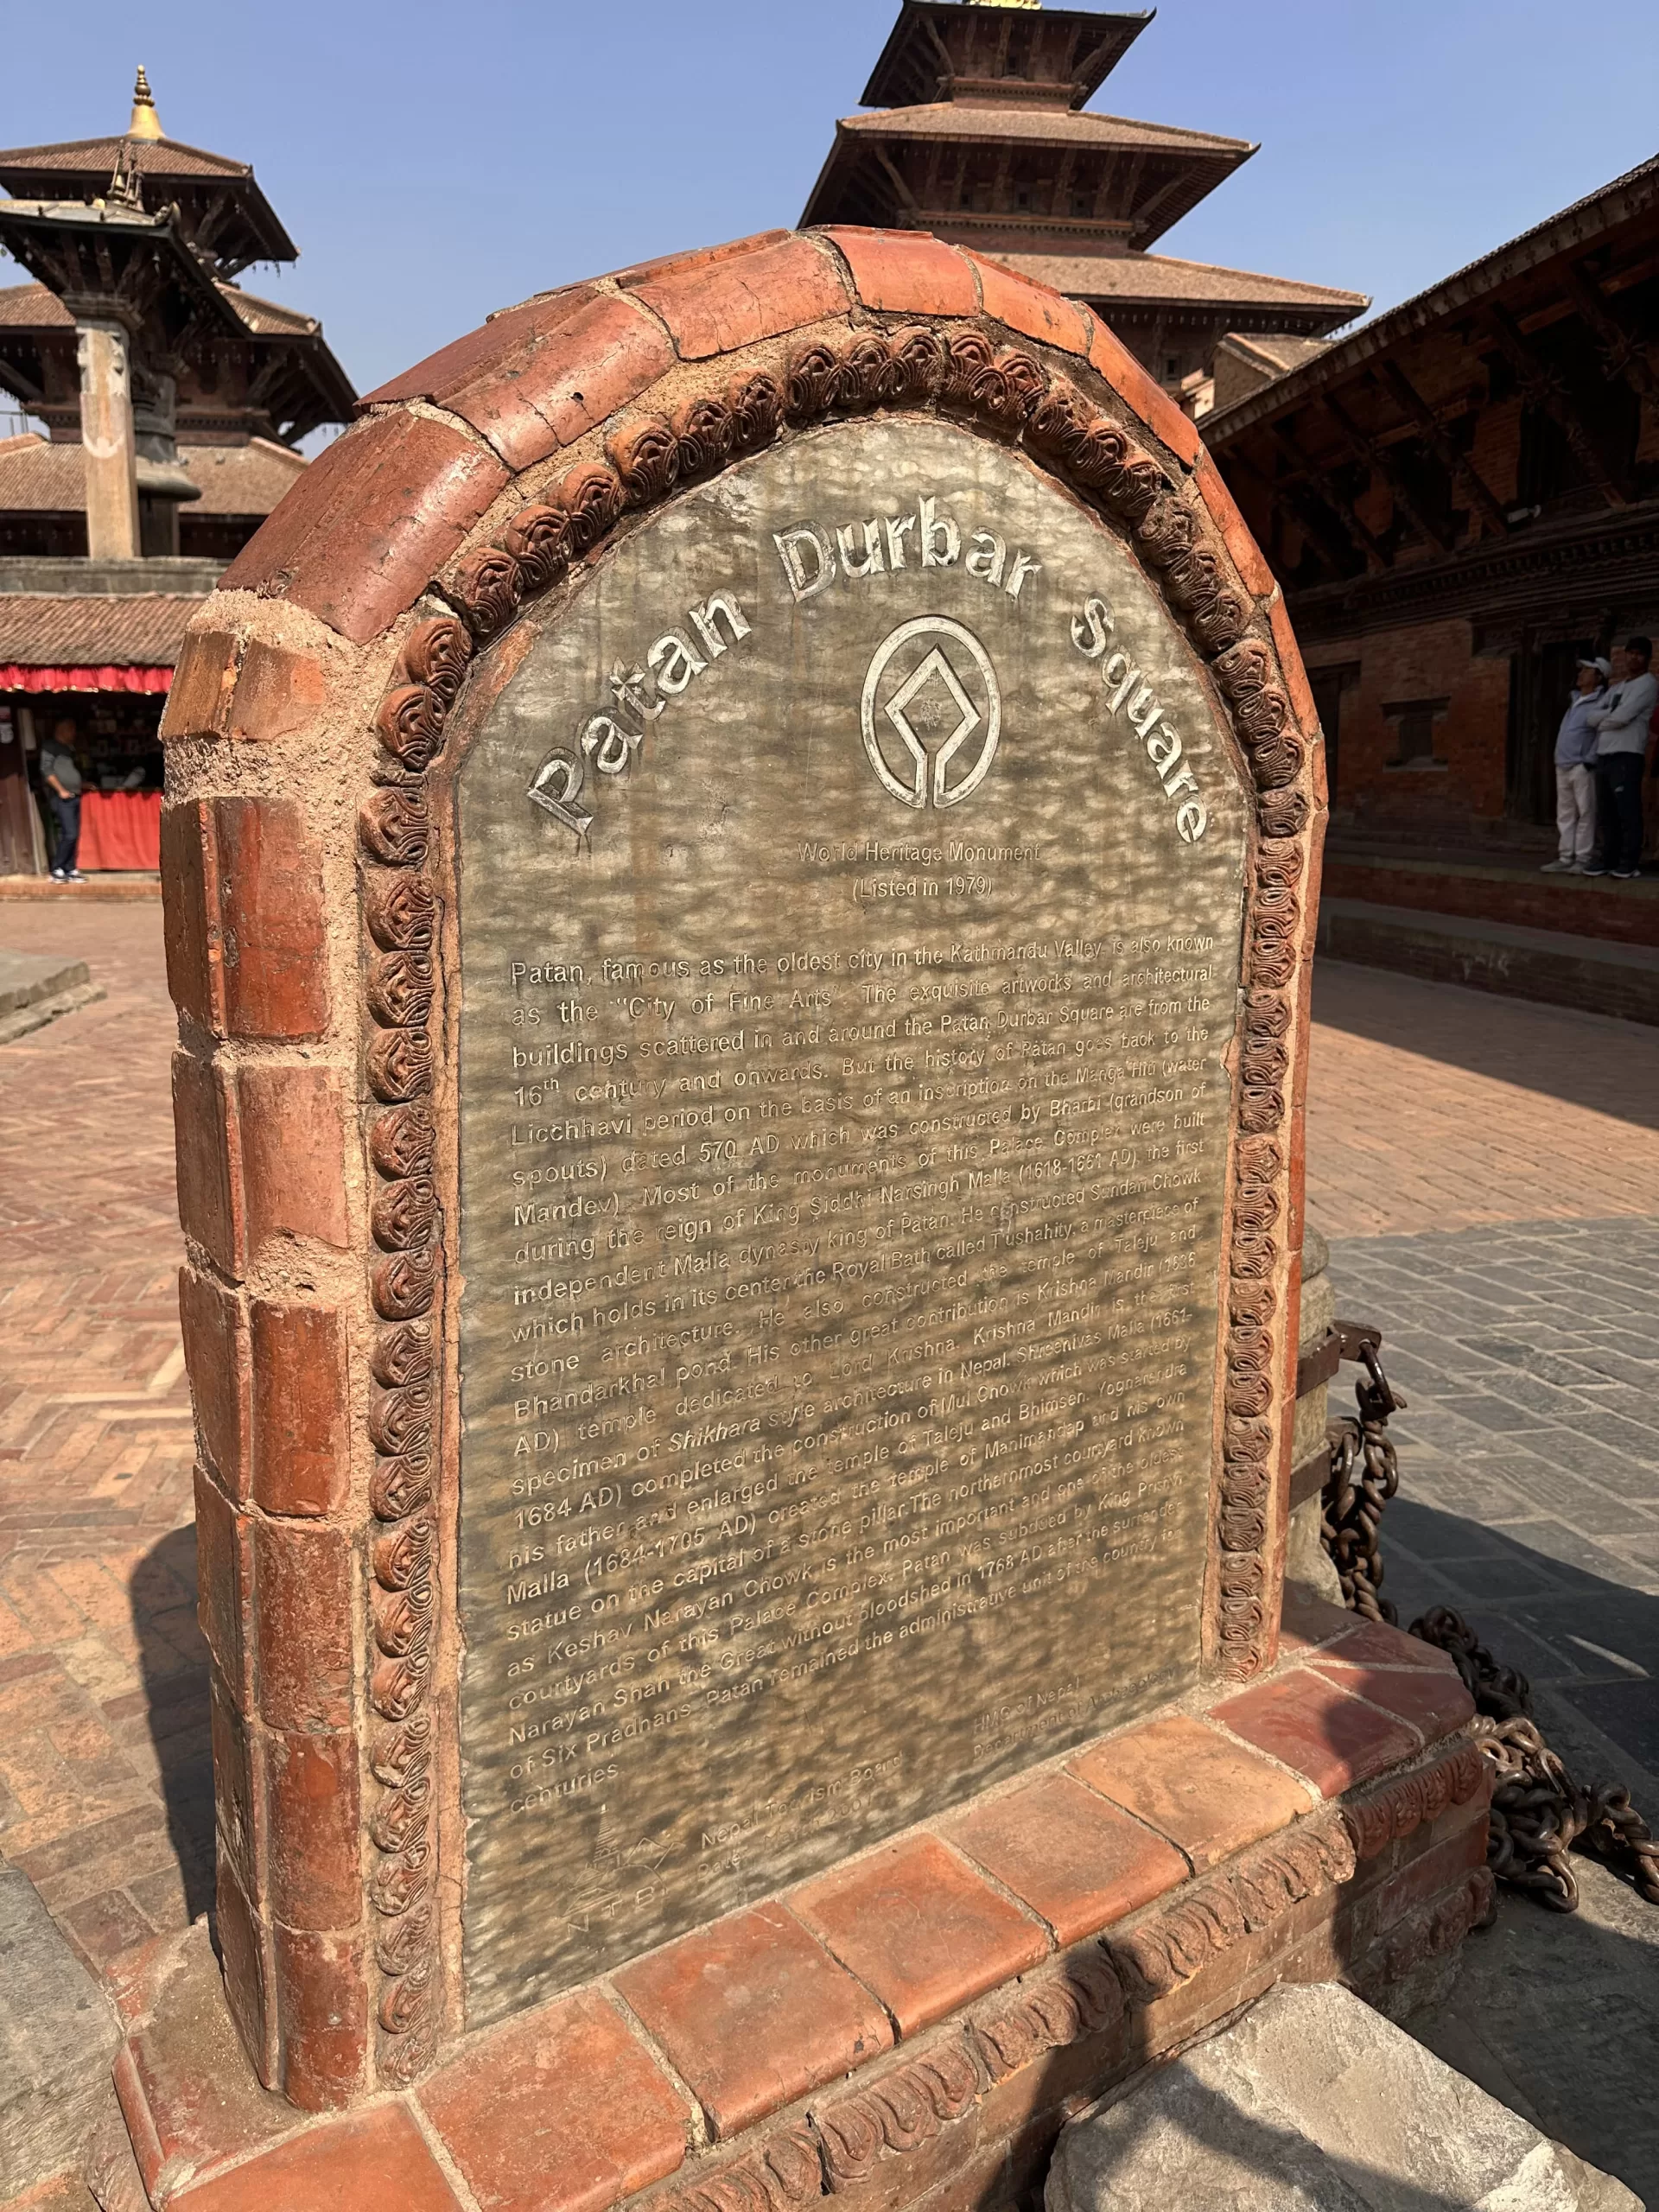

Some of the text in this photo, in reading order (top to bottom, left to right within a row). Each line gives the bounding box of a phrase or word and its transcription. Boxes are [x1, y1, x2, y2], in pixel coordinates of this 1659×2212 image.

[527, 496, 1207, 843] Patan Durbar Square
[798, 840, 1041, 866] World Heritage Monument
[852, 875, 994, 904] (Listed in 1979)
[512, 934, 1213, 985] Patan, famous as the oldest city in the Kathmandu is also known
[559, 963, 1212, 1023] the Fine The exquisite artworks and architectural
[512, 995, 1210, 1068] buildings scattered and around the Durbar Square are from the
[575, 1025, 1208, 1102] century and onwards. But the history Patan goes back the
[512, 1086, 1183, 1190] spouts) dated 570 which was constructed (grandson
[642, 1109, 1205, 1206] Most the monuments this were built
[643, 1068, 1069, 1136] period the basis the
[513, 1166, 1201, 1305] independent Malla king Chowk
[514, 1136, 1204, 1264] during the reign King Siddhi Narsingh Malla the first
[511, 1223, 1196, 1382] stone also constructed Taleju and
[512, 1203, 1179, 1342] which holds its Royal Bath called masterpiece
[512, 1319, 1144, 1495] specimen Shikhara Nepal. Malla
[513, 1275, 1096, 1420] Bhandarkhal His other great contribution Krishna
[513, 1319, 1035, 1456] AD) temple dedicated Krishna
[513, 1354, 1115, 1530] 1684 AD) completed the Mul which was
[556, 1390, 1089, 1554] father enlarged Taleju and Bhimsen.
[507, 1477, 880, 1605] Malla AD) the
[508, 1548, 744, 1640] statue the capital
[547, 1495, 1014, 1664] Keshav Narayan Chowk the most important
[508, 1552, 1014, 1746] Narayan the Great 1768
[509, 1536, 990, 1710] courtyards this Palace Patan was
[542, 1628, 893, 1769] Six Patan the
[973, 1709, 1064, 1762] Department
[1036, 1673, 1079, 1707] Nepal
[701, 1808, 759, 1850] Nepal
[851, 1748, 903, 1786] Board
